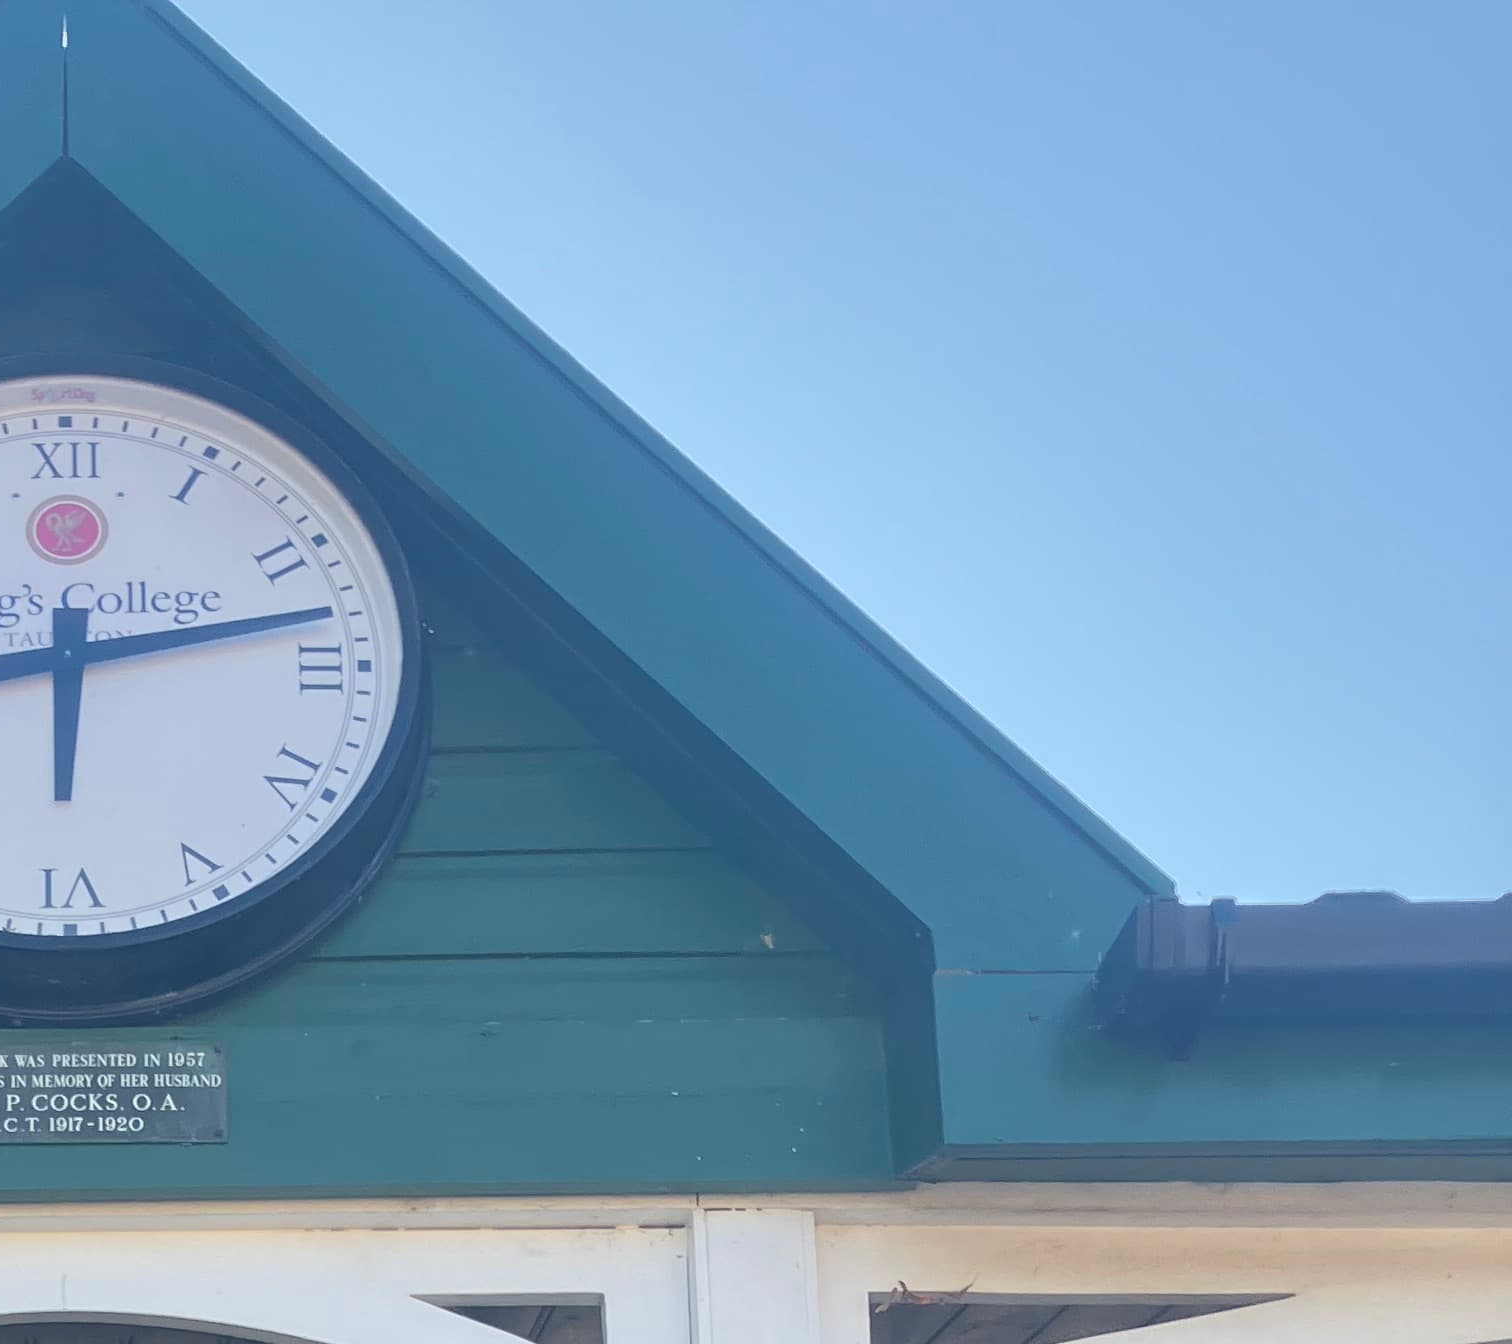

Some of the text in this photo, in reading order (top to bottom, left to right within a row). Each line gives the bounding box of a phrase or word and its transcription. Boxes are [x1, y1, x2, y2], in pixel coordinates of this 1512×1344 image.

[31, 442, 101, 480] XII
[61, 580, 222, 625] College
[14, 1053, 46, 1068] WAS
[52, 1053, 137, 1068] PRESENTED
[144, 1053, 161, 1068] IN
[168, 1051, 206, 1067] 1957
[10, 1074, 28, 1089] IN
[31, 1073, 94, 1089] MEMORY
[120, 1074, 150, 1088] HER
[154, 1073, 223, 1088] HUSBAND
